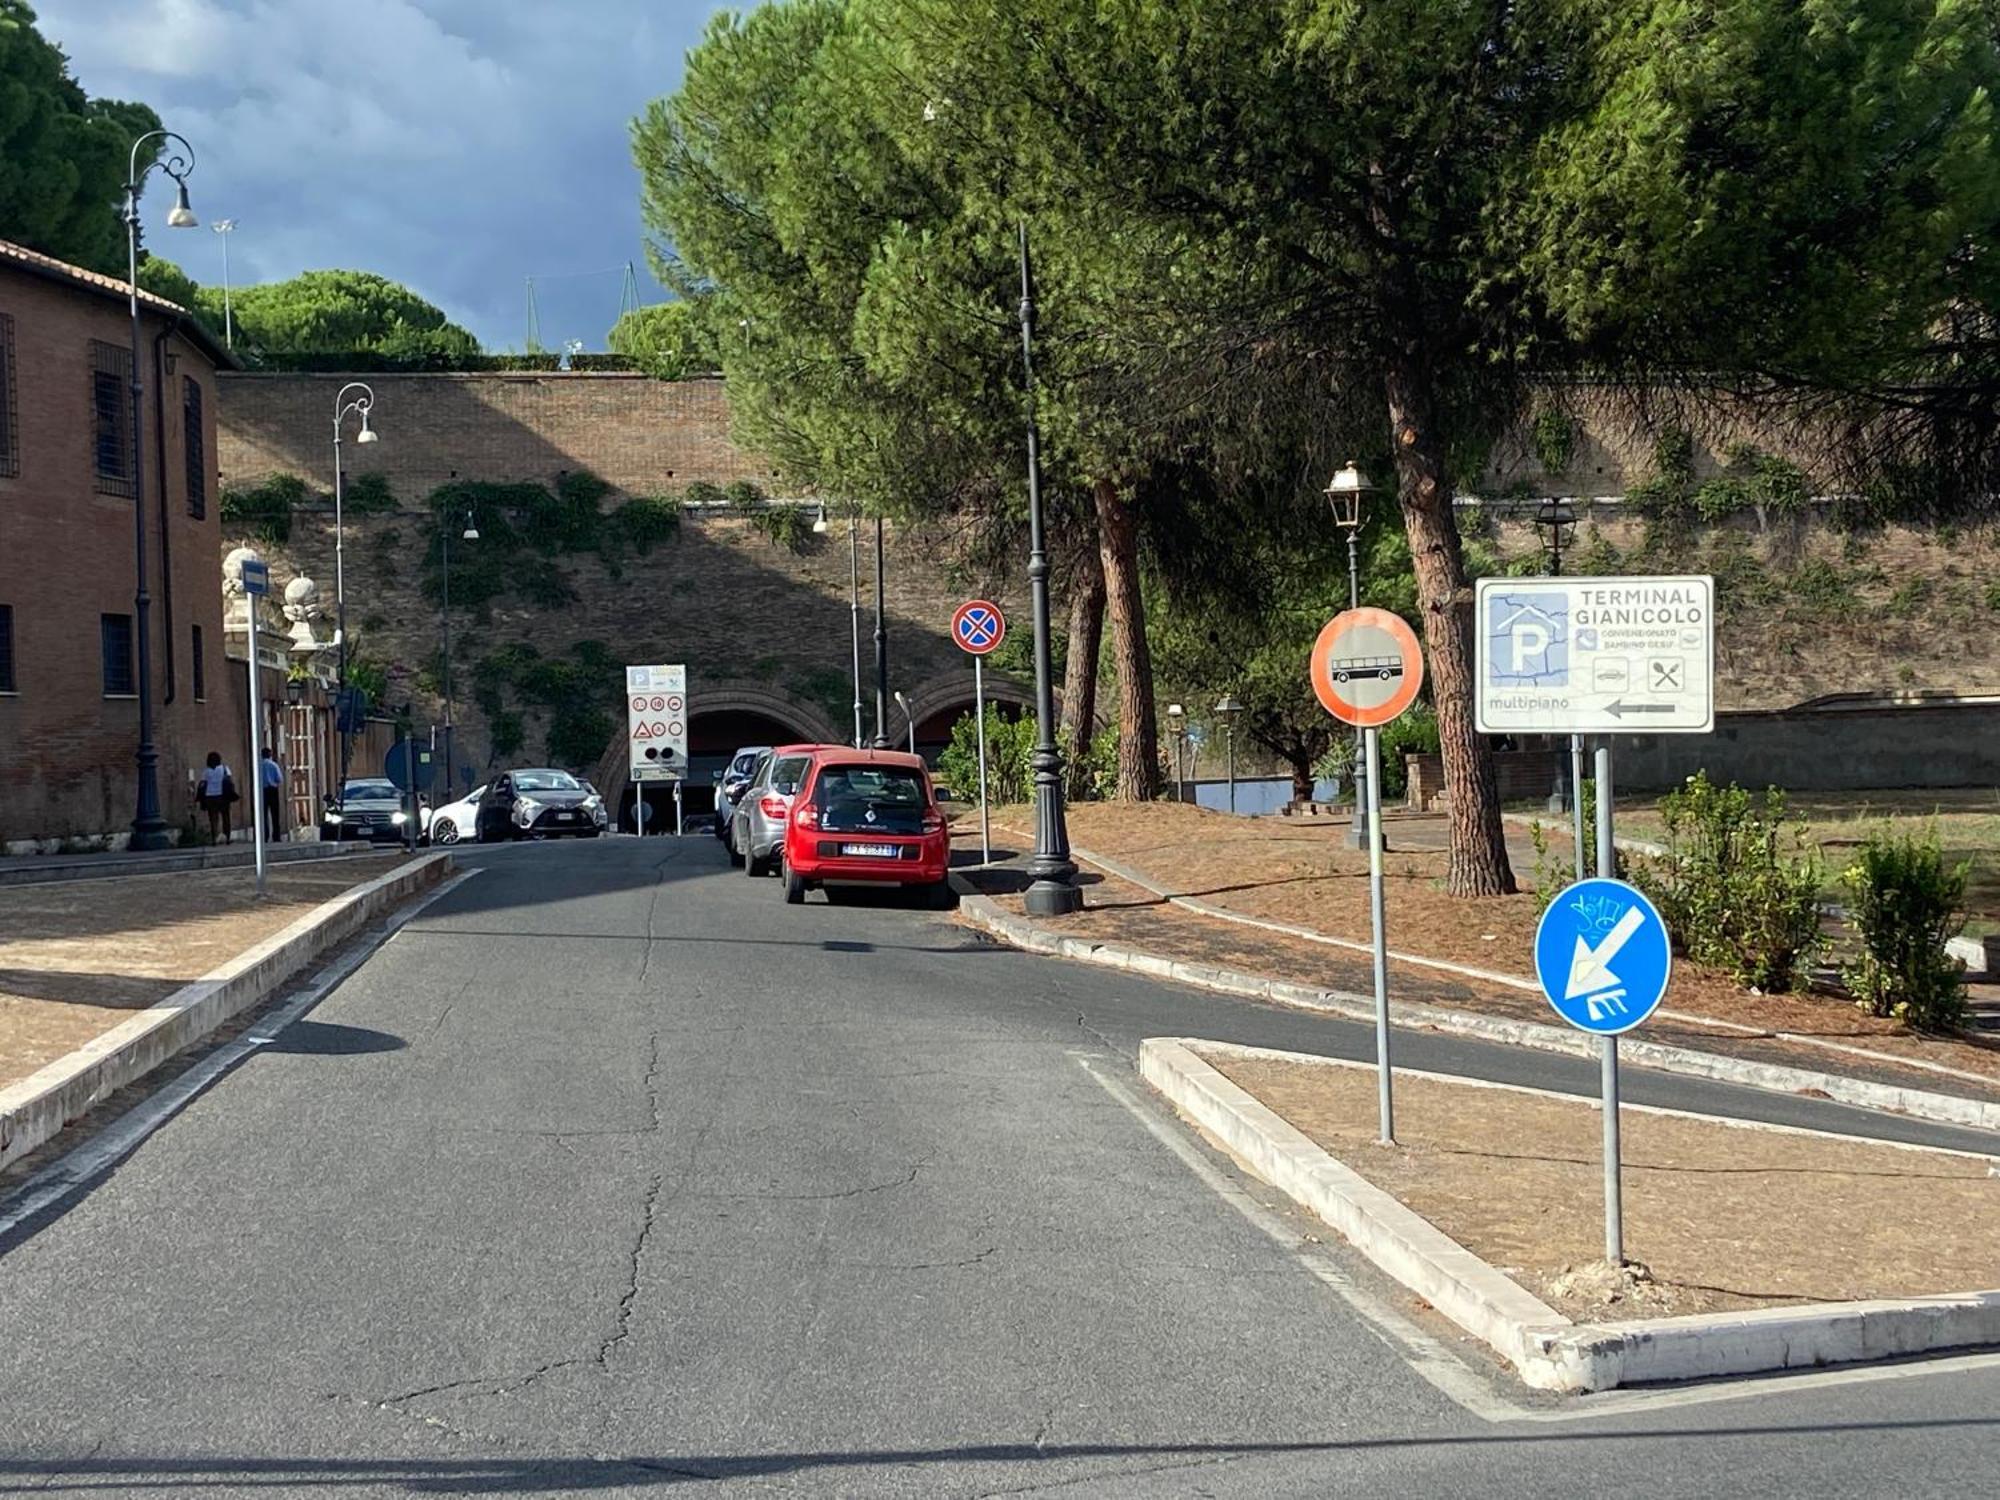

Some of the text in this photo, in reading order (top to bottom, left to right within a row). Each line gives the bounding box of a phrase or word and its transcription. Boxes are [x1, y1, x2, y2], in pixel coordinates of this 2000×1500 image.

[1581, 589, 1696, 605] TERMINAL
[1576, 608, 1702, 625] GIANICOLO
[1511, 623, 1549, 672] P
[1489, 696, 1569, 711] multipiano
